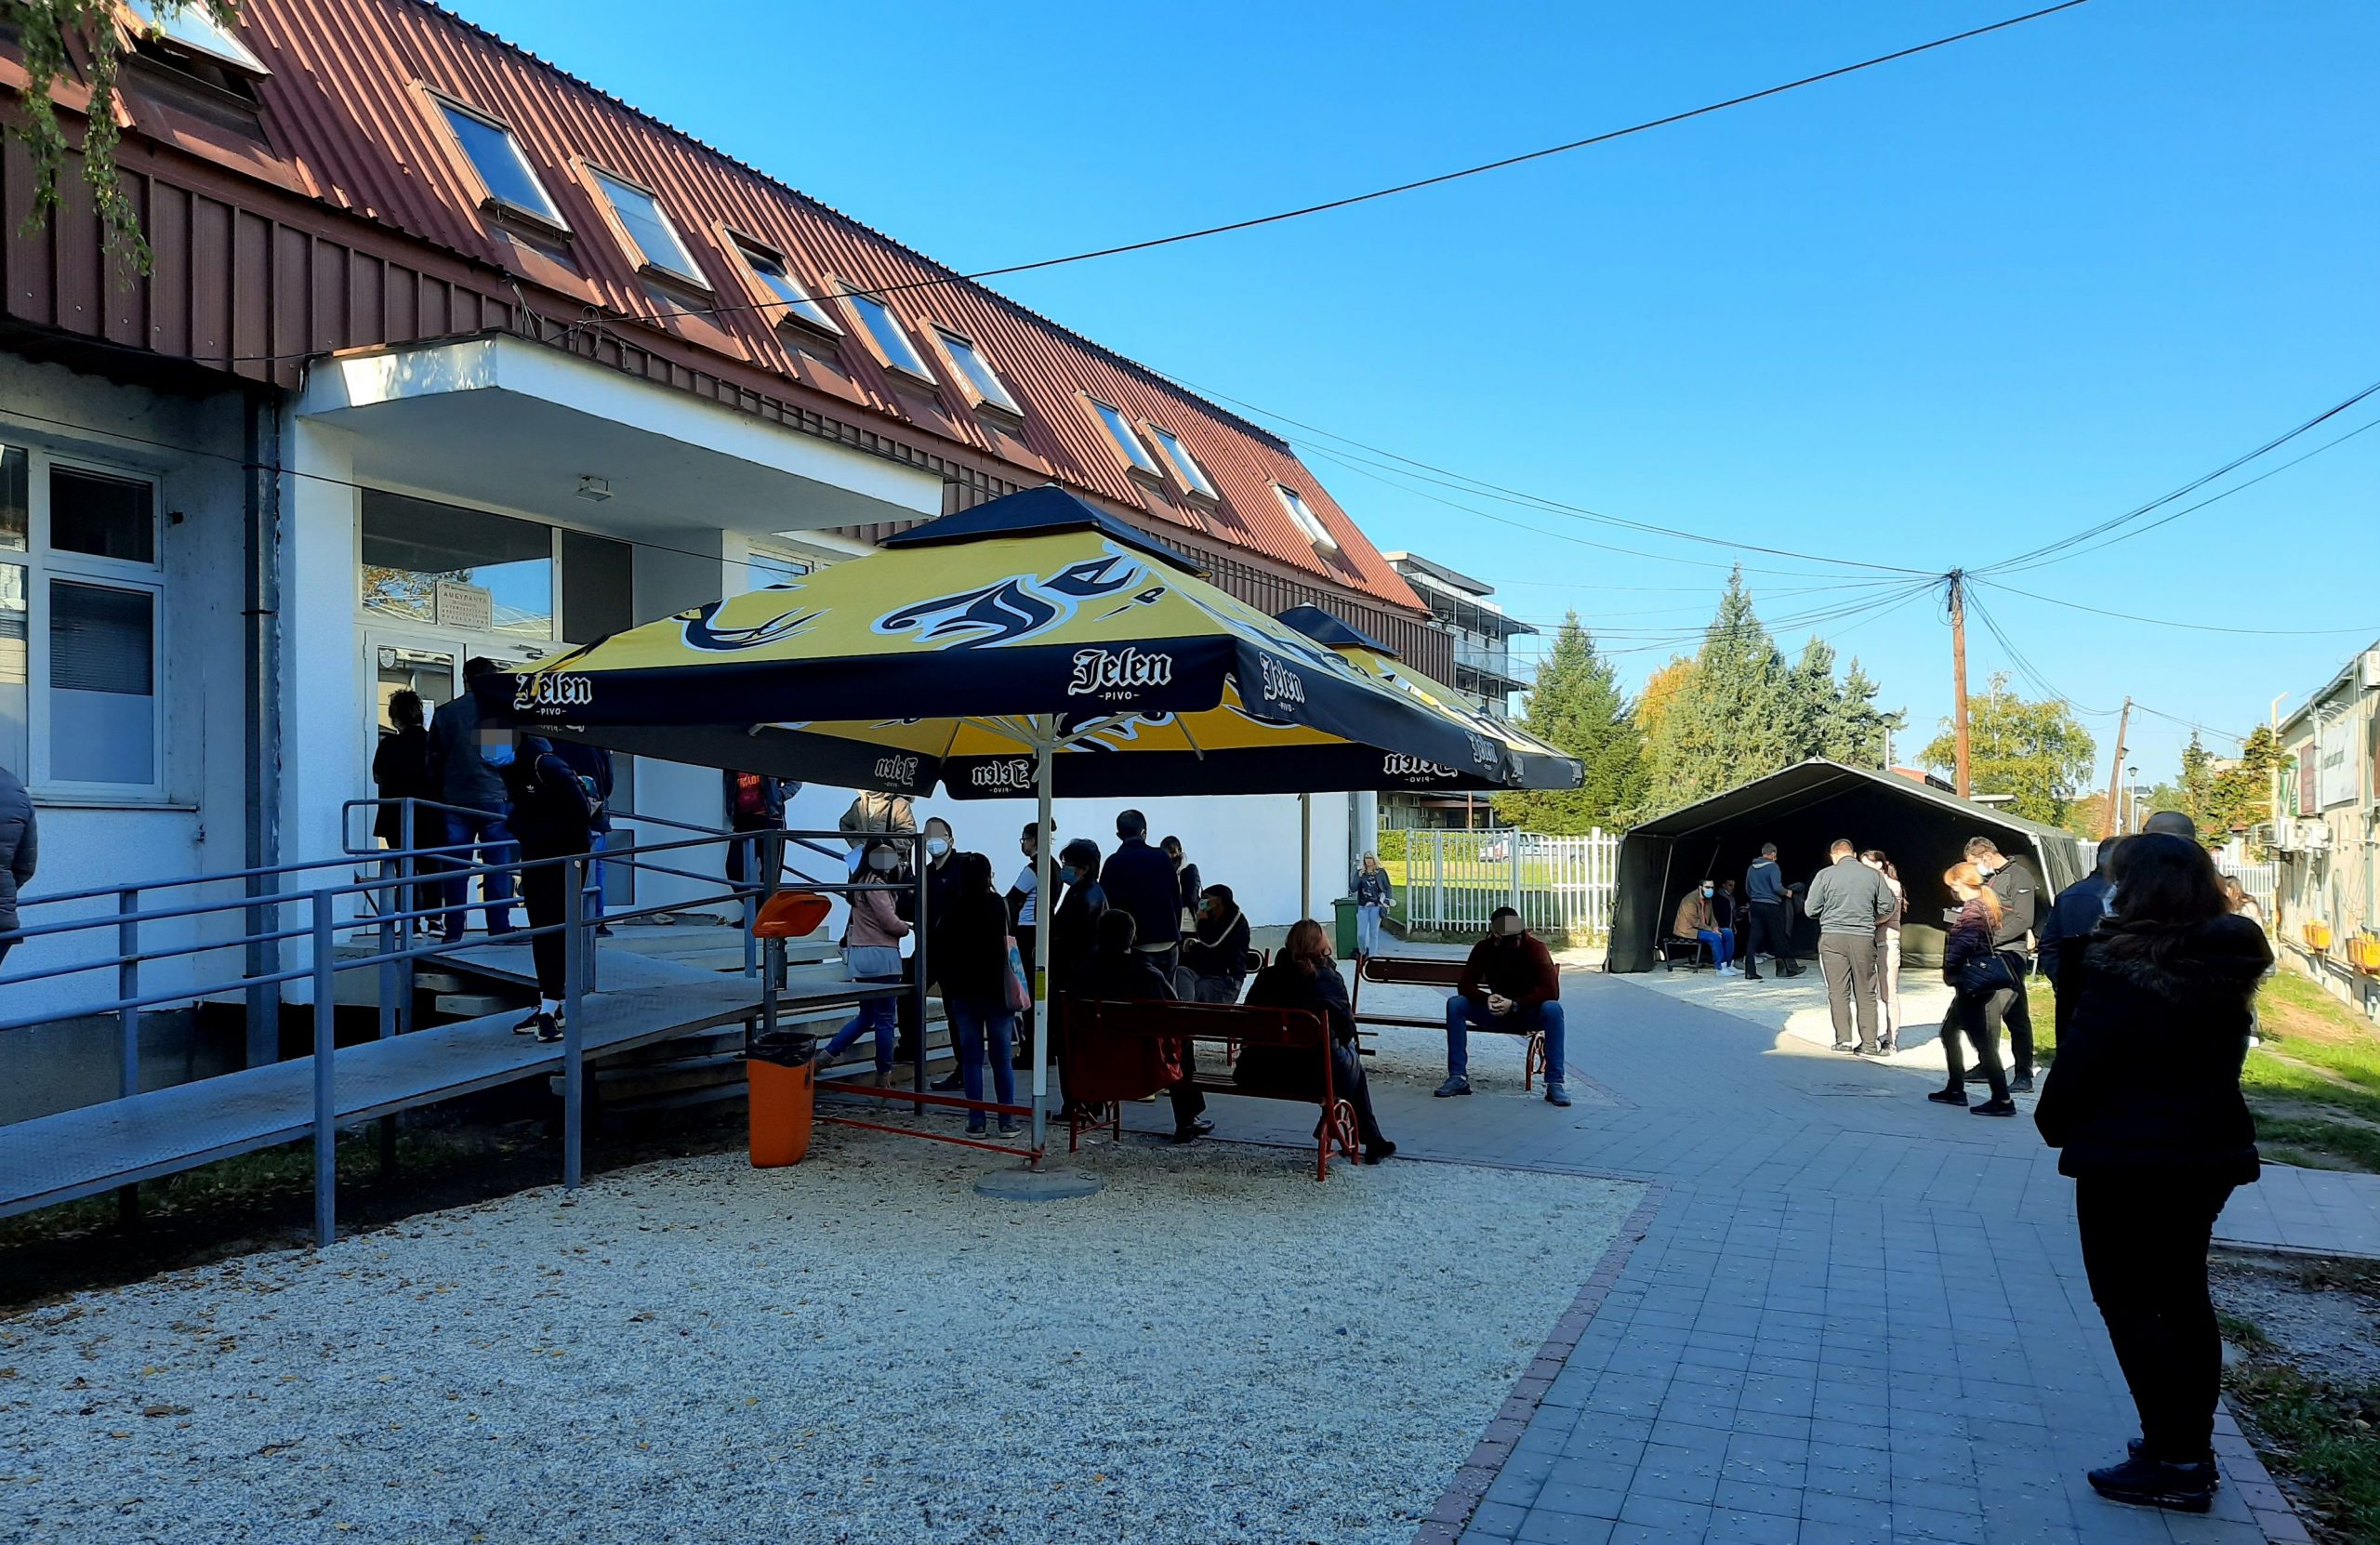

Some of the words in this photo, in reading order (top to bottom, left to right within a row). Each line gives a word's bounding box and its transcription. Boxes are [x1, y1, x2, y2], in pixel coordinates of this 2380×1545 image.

[513, 672, 592, 711] Jelen
[1068, 647, 1172, 696] Jelen
[1259, 651, 1305, 704] Jelen
